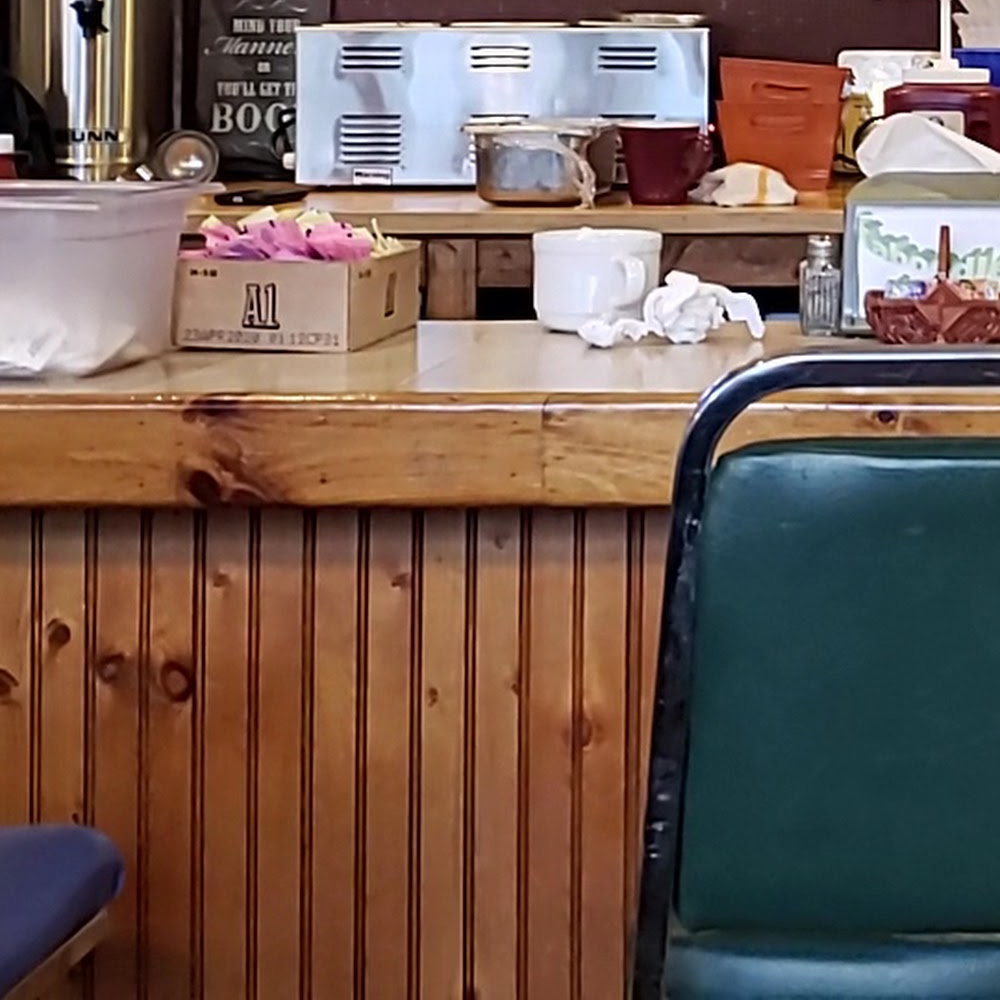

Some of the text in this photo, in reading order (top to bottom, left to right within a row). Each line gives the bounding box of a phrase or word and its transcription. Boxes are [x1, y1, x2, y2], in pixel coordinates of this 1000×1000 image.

[214, 36, 297, 56] Manne
[58, 130, 119, 143] UNN
[242, 282, 281, 330] A1
